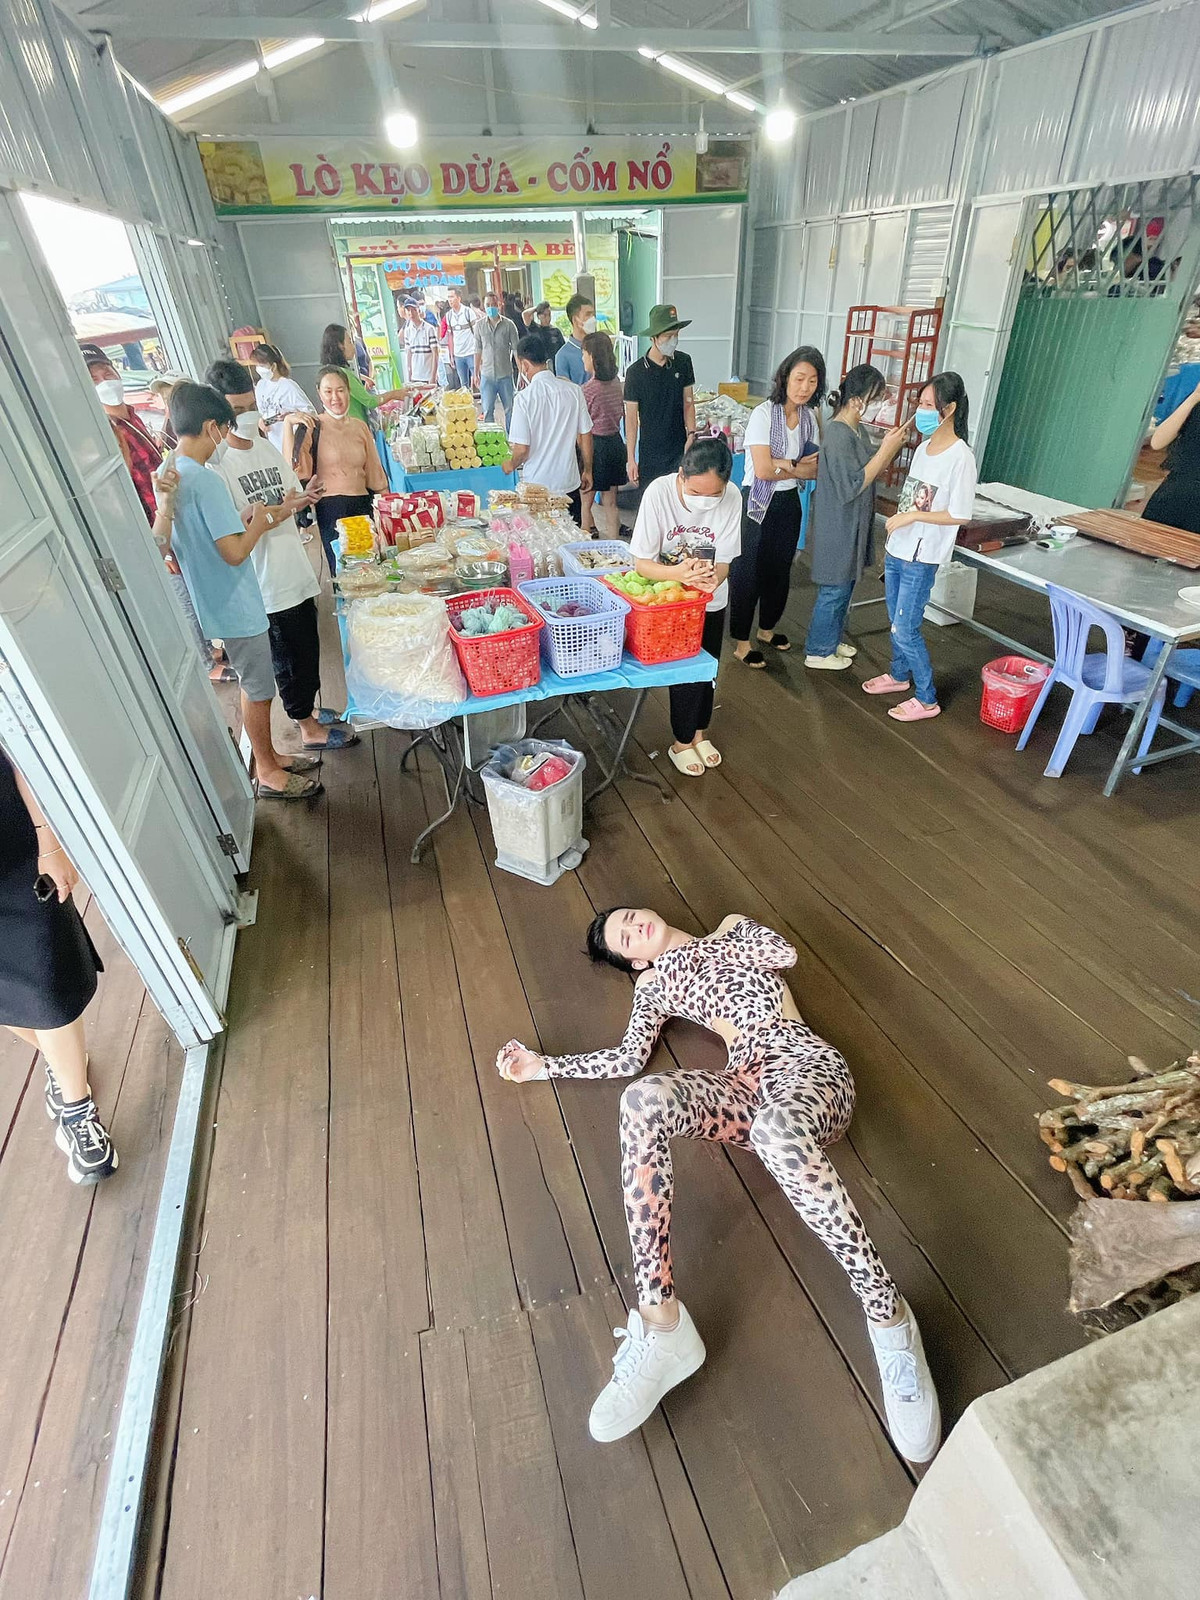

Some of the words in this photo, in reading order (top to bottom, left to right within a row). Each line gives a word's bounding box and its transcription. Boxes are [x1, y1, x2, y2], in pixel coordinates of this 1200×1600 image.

[289, 153, 341, 196] LÒ
[351, 162, 430, 204] KẸO
[440, 153, 519, 194] DỪA
[546, 146, 617, 193] CỐM
[627, 141, 672, 191] NỔ
